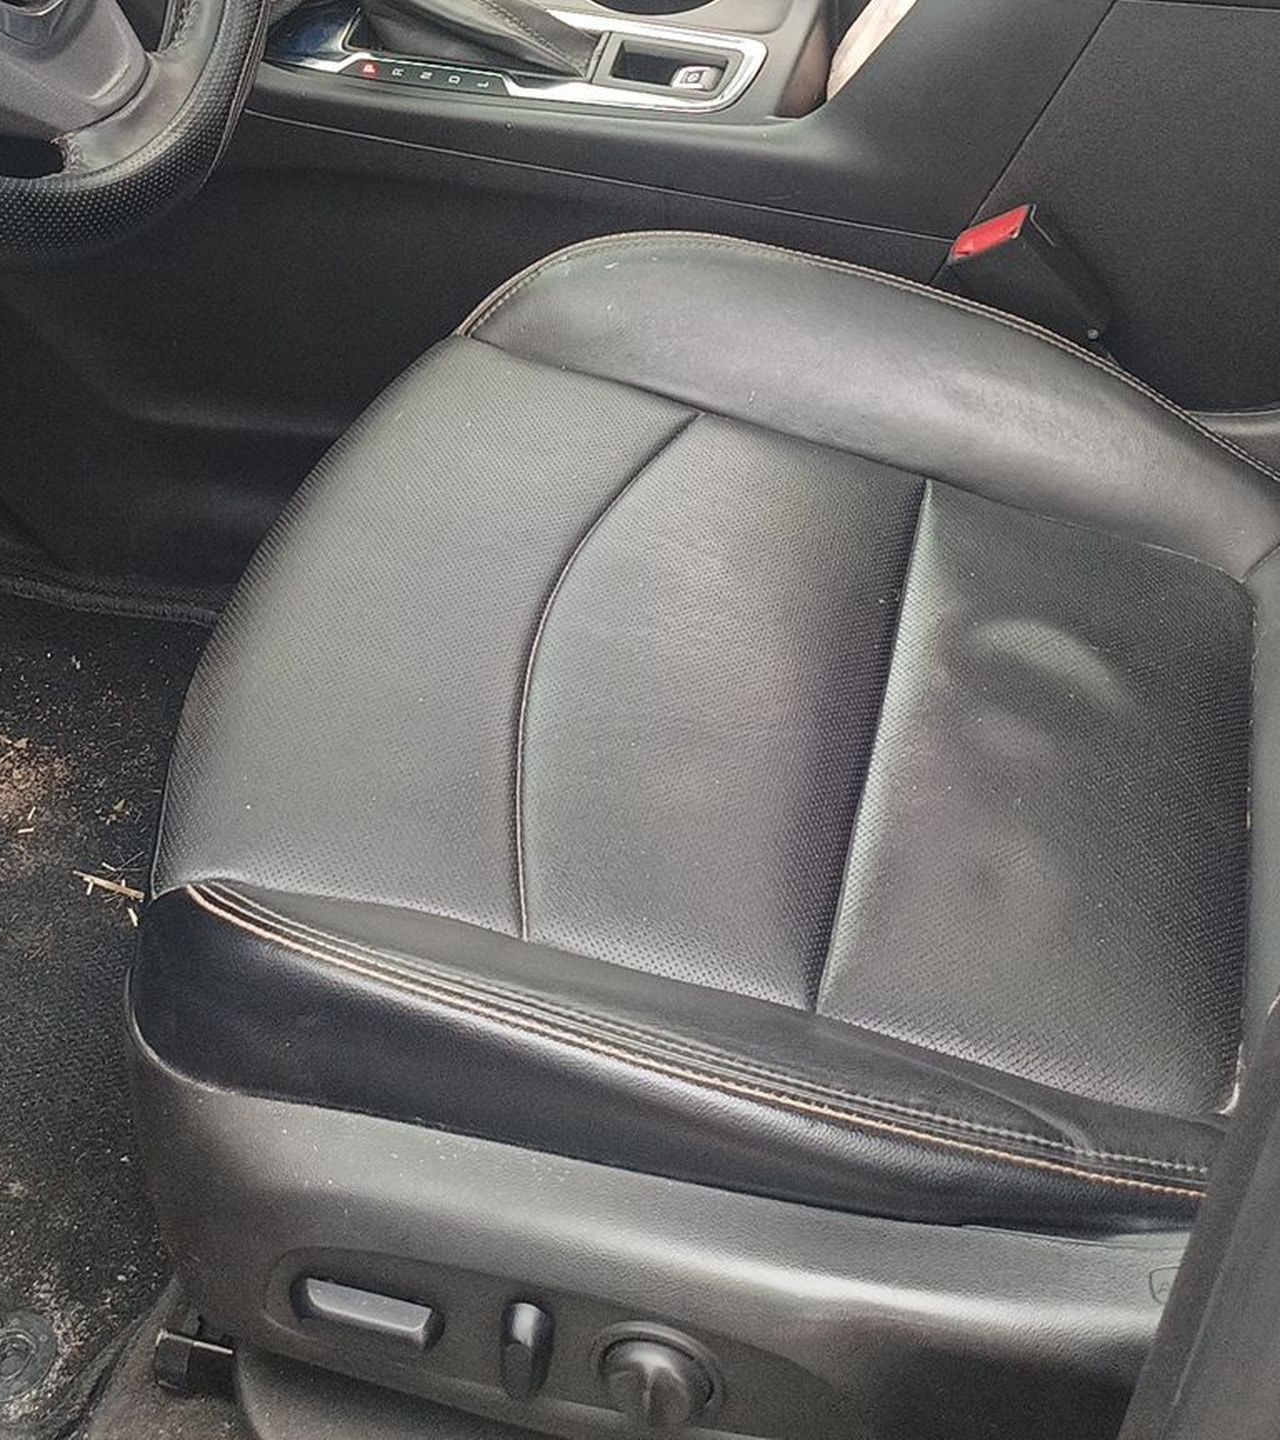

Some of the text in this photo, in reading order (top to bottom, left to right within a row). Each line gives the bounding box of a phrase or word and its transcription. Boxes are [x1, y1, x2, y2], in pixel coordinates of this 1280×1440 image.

[363, 64, 375, 73] P
[392, 68, 404, 76] R
[448, 75, 461, 84] D
